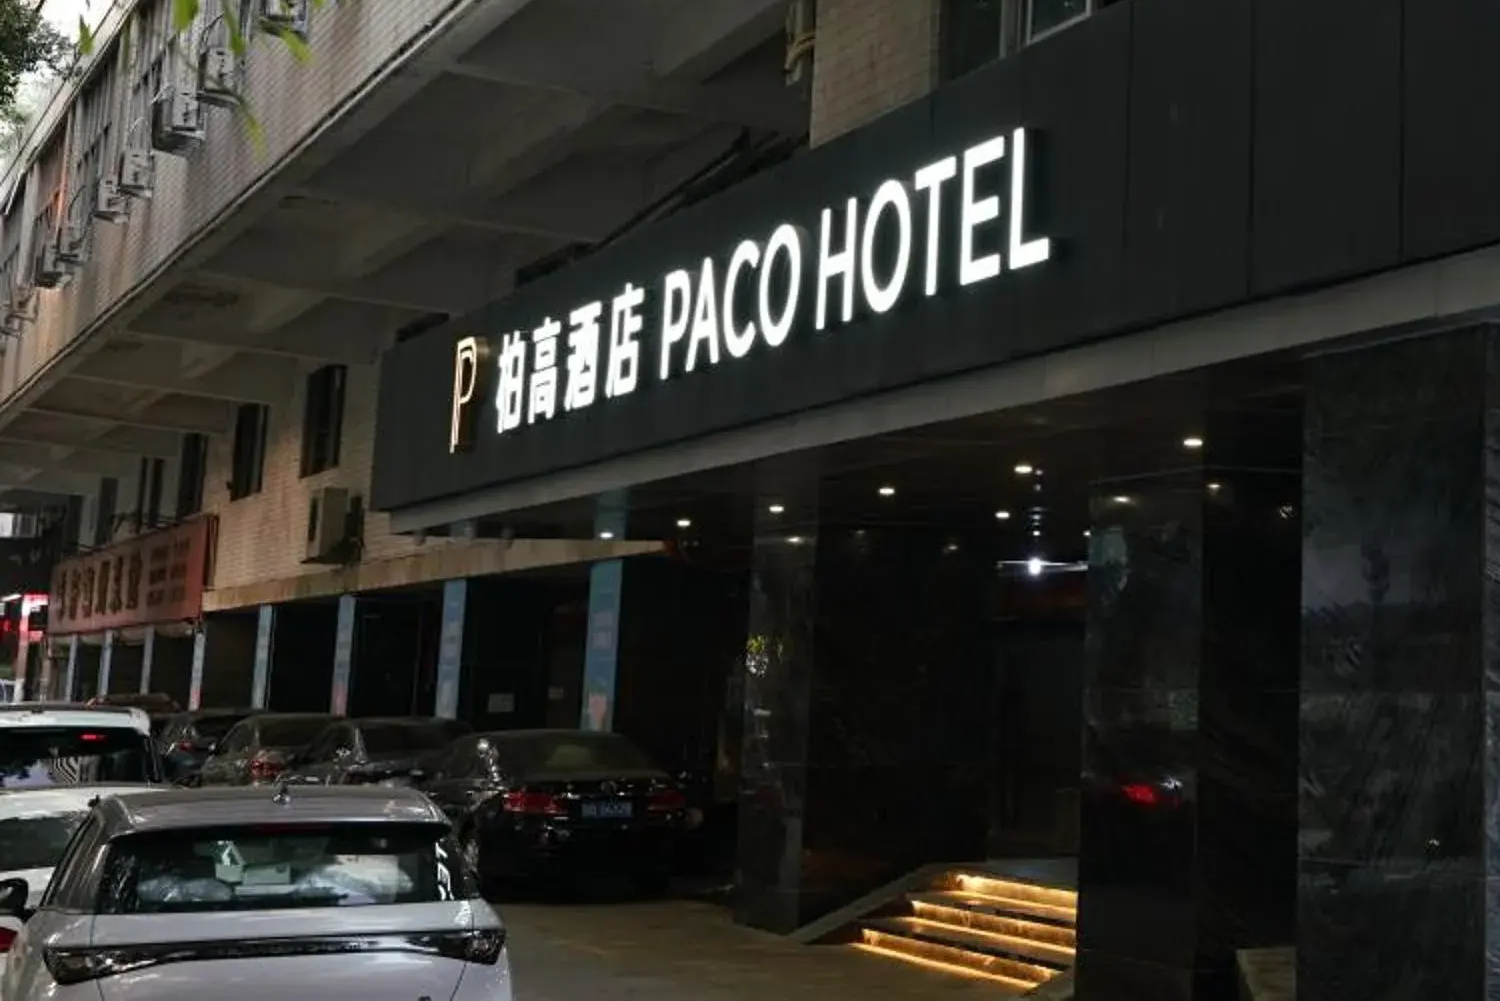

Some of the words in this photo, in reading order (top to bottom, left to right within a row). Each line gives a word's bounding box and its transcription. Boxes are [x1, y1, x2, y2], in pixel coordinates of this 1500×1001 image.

[660, 223, 801, 381] PACO
[815, 127, 1050, 331] HOTEL
[495, 282, 645, 433] 柏高酒店
